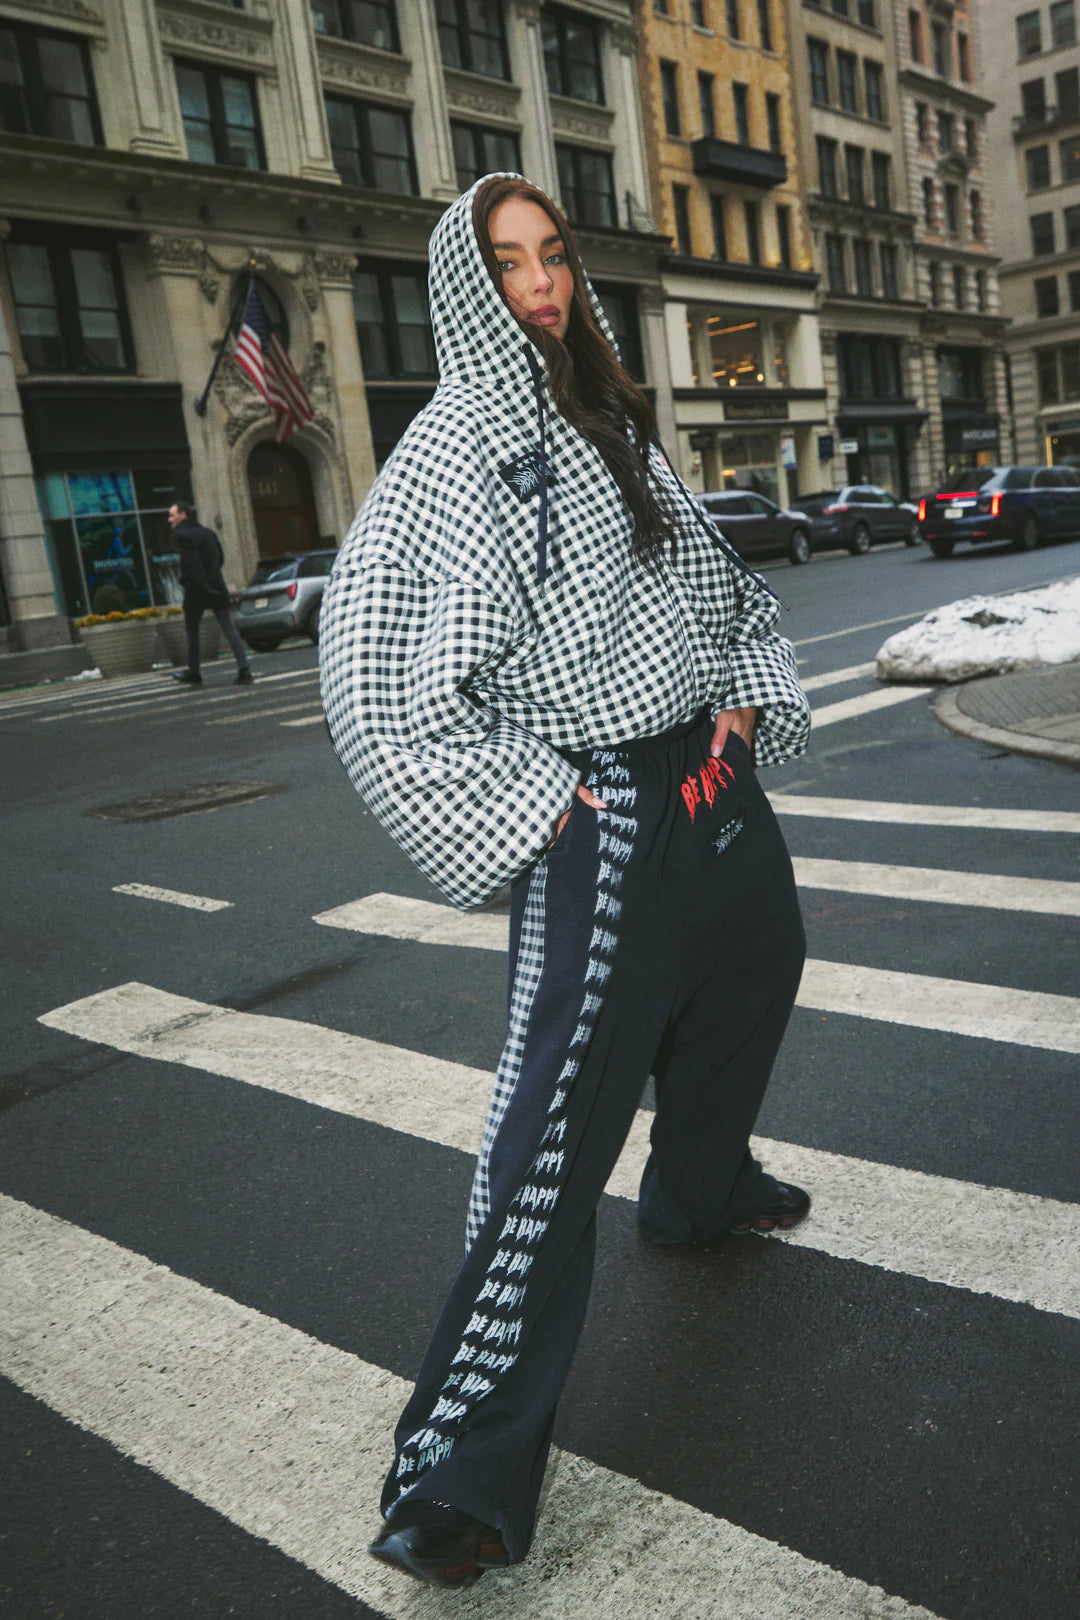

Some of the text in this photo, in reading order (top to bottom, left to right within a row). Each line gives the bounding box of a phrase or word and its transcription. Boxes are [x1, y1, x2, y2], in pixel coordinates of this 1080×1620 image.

[602, 785, 638, 810] HAPPY
[681, 774, 701, 824] BE
[598, 829, 634, 865] BE HAPPY
[596, 858, 611, 885] BE
[593, 889, 608, 916] BE
[587, 924, 603, 951] BE
[583, 956, 598, 984] BE
[579, 990, 593, 1017] BE
[568, 1022, 586, 1048] BE
[556, 1057, 576, 1084] BE
[546, 1086, 566, 1114] BE
[520, 1183, 560, 1213] HAPPY
[497, 1213, 518, 1242] BE
[485, 1248, 512, 1273] BE
[474, 1278, 501, 1304] BE
[461, 1311, 489, 1336] BE
[449, 1341, 477, 1366] BE
[440, 1372, 465, 1392] BE
[428, 1394, 453, 1421] BE
[396, 1452, 416, 1479] BE
